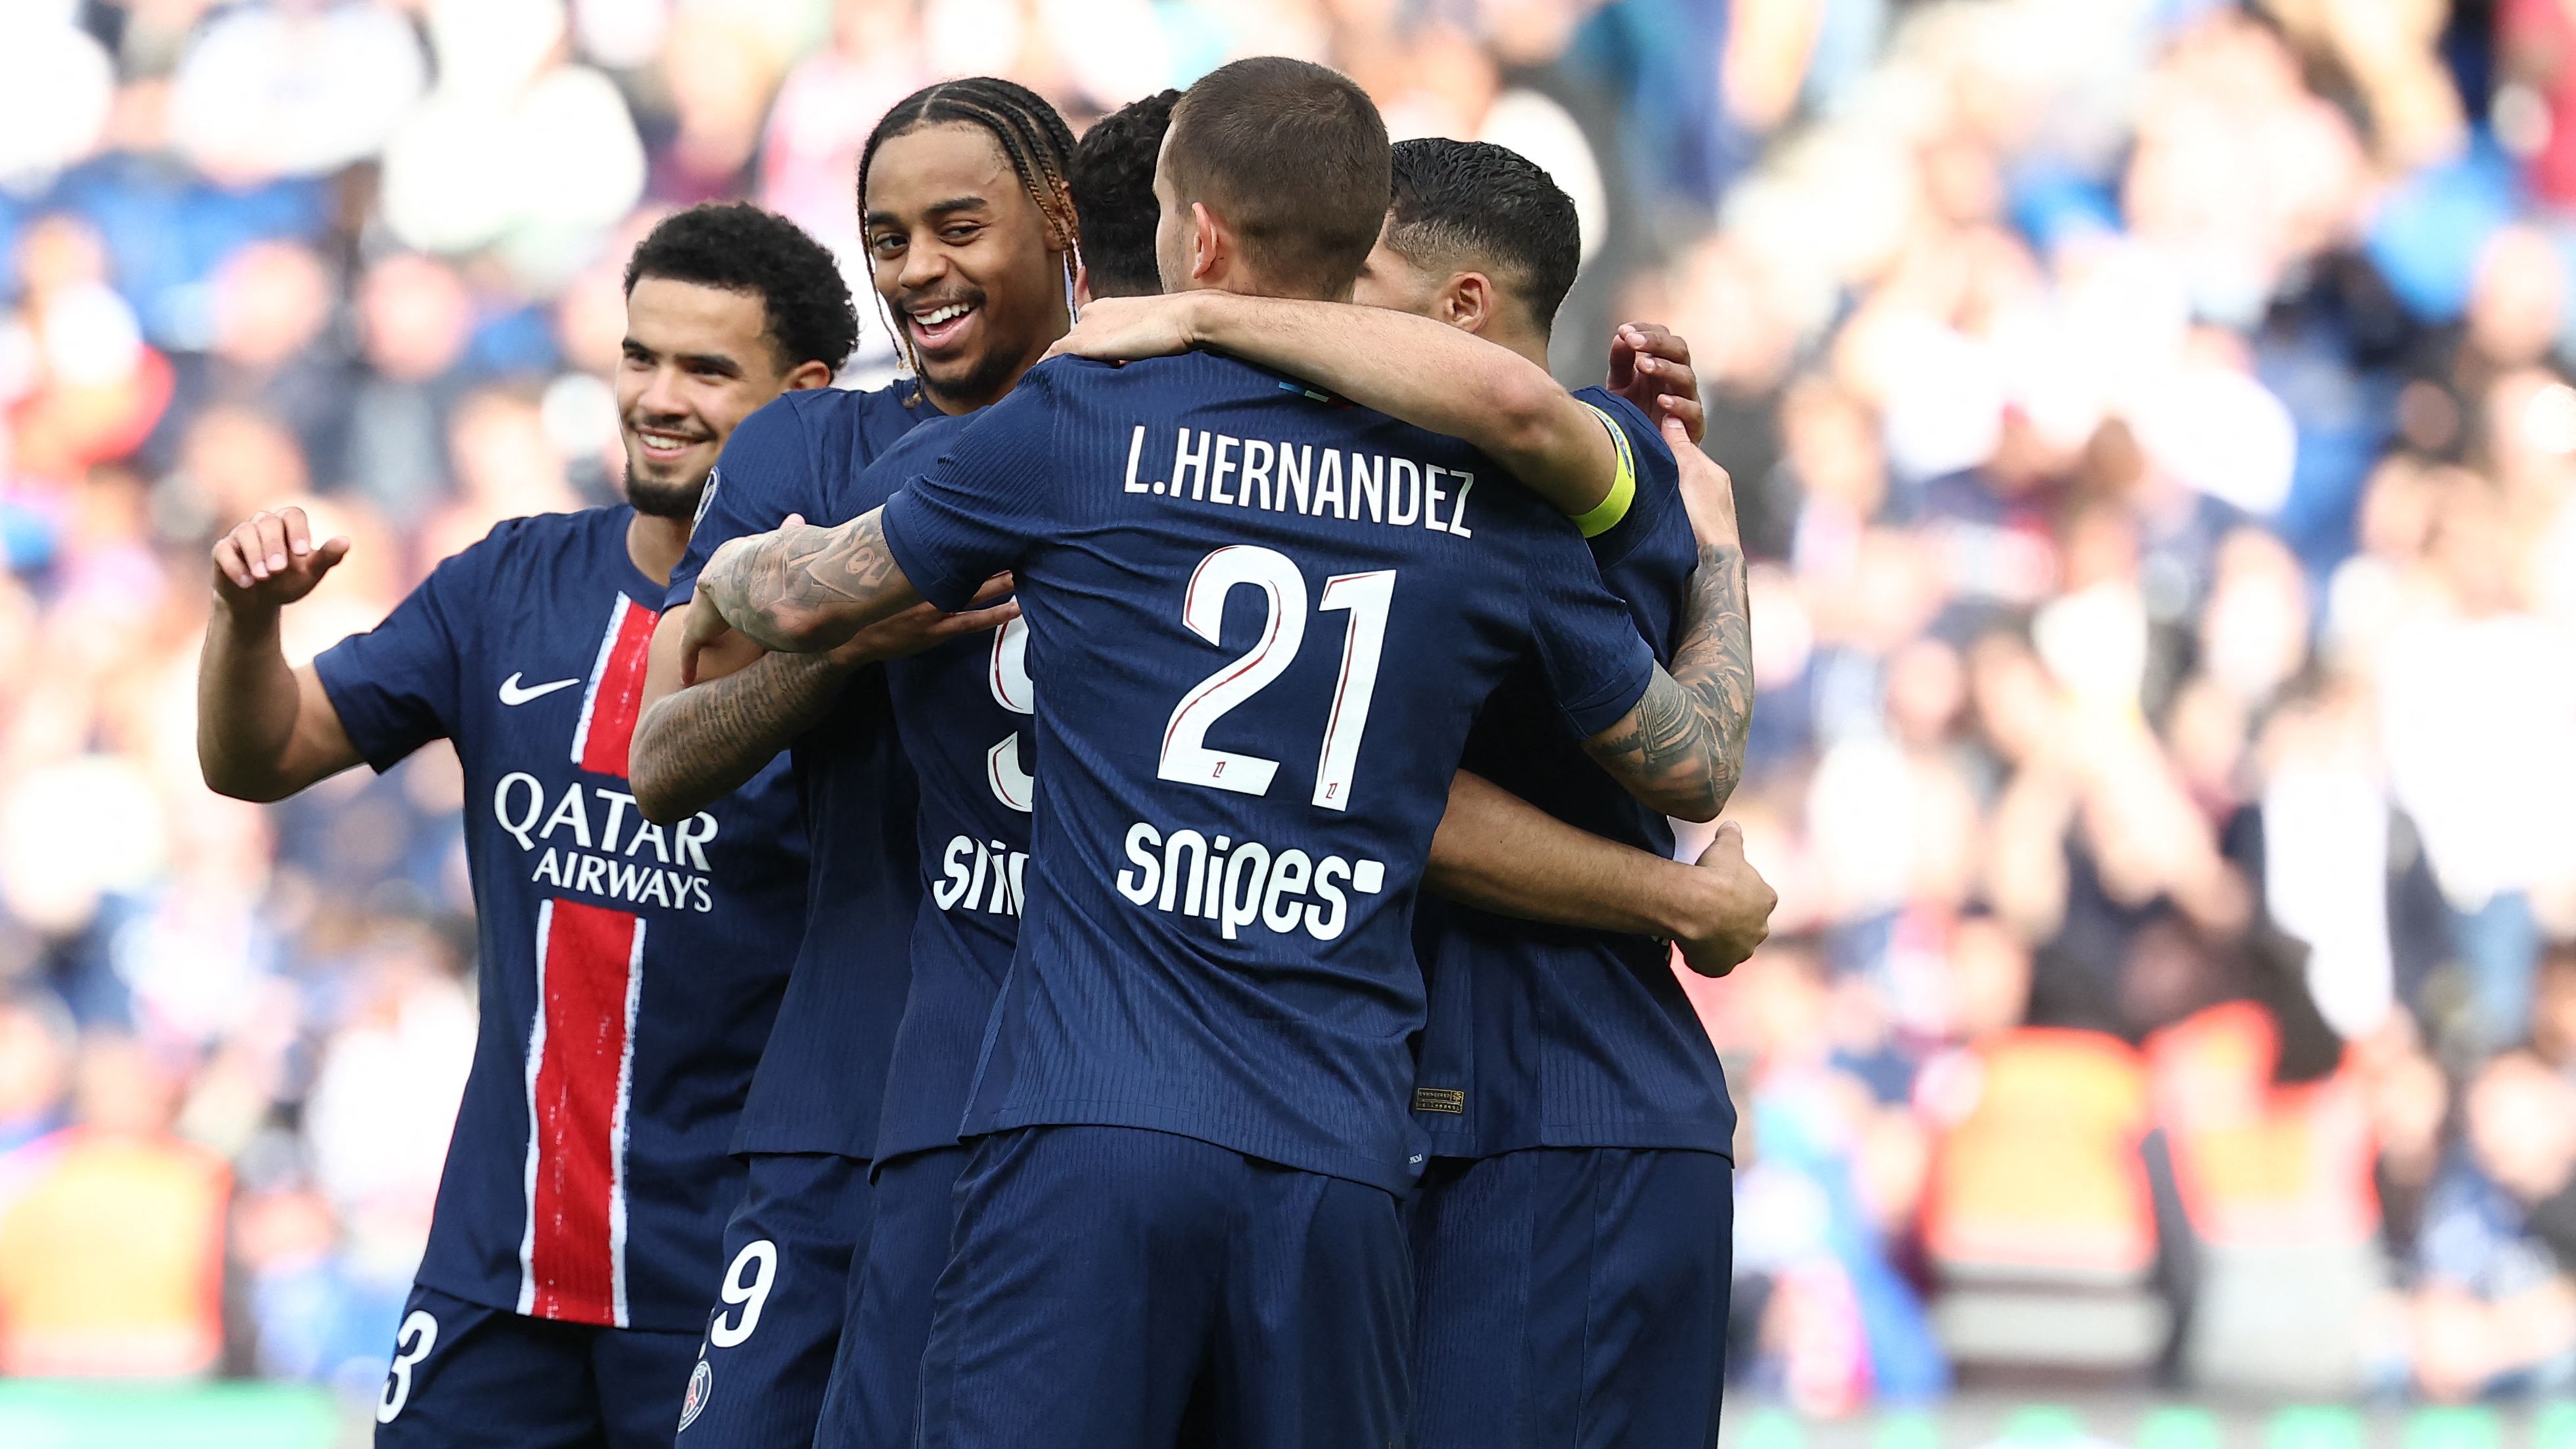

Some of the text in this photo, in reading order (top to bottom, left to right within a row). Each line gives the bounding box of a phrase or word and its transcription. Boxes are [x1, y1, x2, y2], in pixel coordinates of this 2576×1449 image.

[1124, 425, 1474, 539] L.HERNANDEZ
[1157, 544, 1397, 812] 21
[494, 772, 718, 871] QATAR
[532, 847, 713, 912] AIRWAYS
[1116, 822, 1352, 940] snipes
